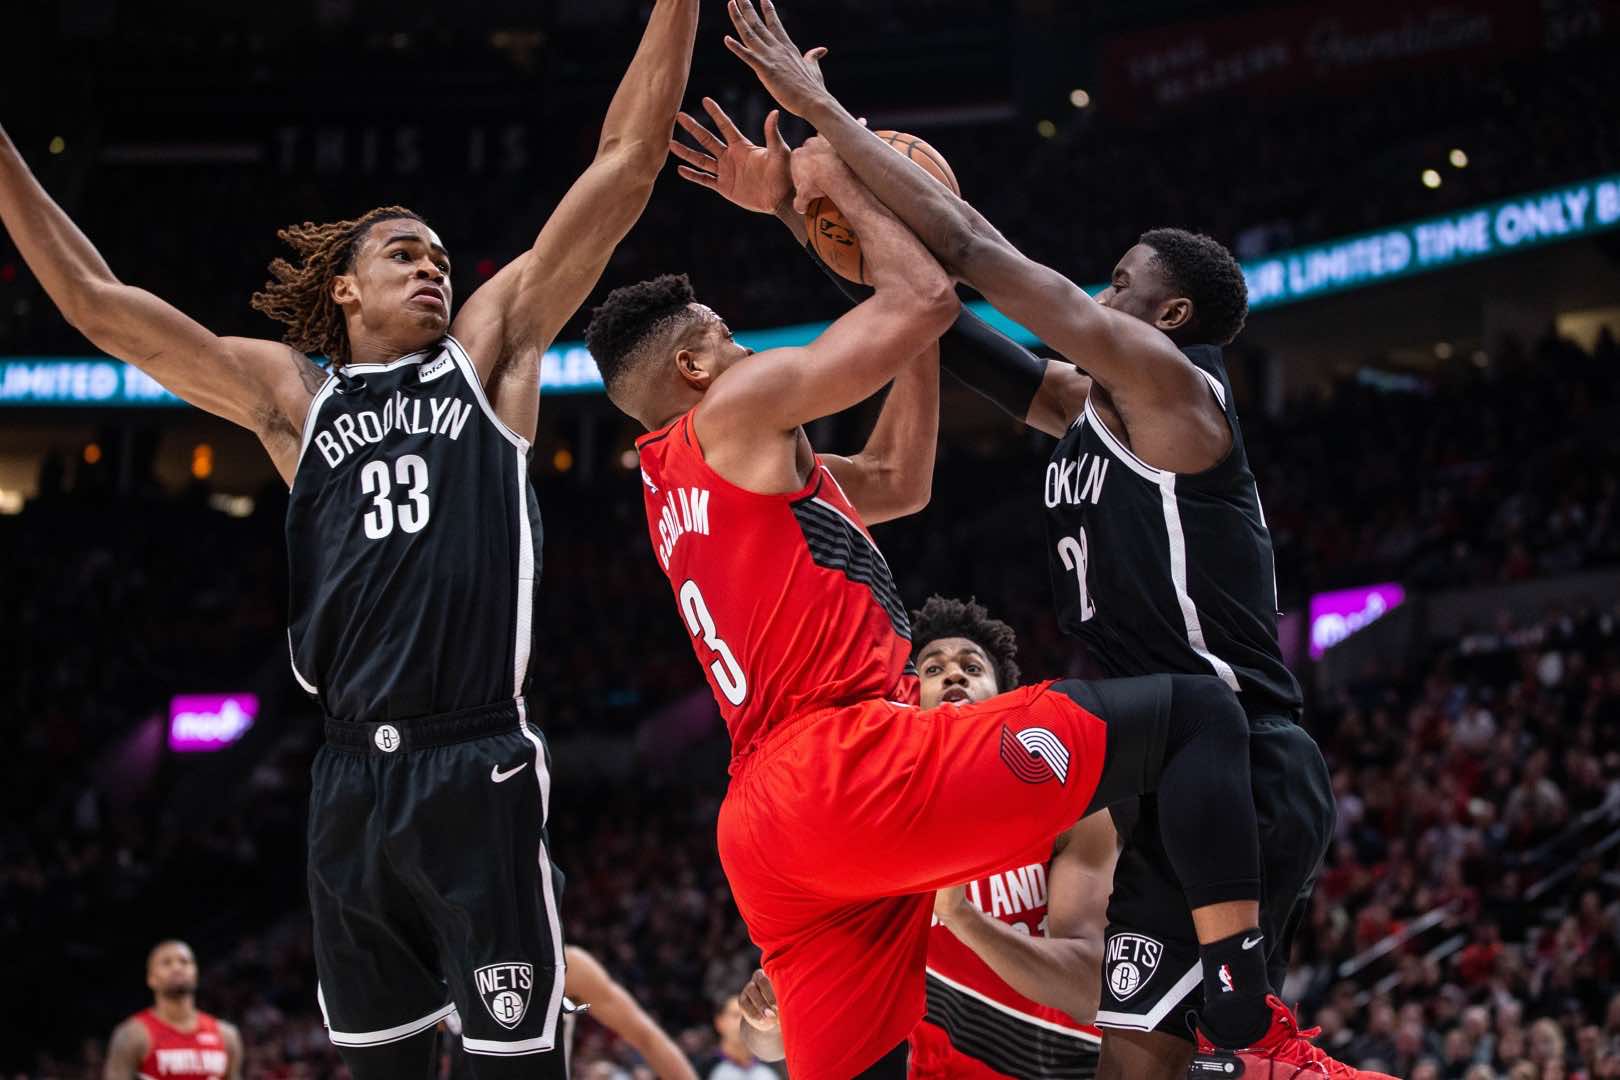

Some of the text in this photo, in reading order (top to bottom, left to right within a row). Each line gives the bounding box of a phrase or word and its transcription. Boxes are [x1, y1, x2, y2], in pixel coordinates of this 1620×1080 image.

[1288, 231, 1412, 294] LIMITED
[1414, 210, 1490, 264] TIME
[1495, 186, 1589, 246] ONLY
[314, 390, 473, 469] BROOKLYN
[360, 454, 430, 540] 33
[679, 578, 748, 706] 3
[478, 965, 531, 995] NETS
[1107, 936, 1158, 968] NETS
[503, 996, 515, 1019] B
